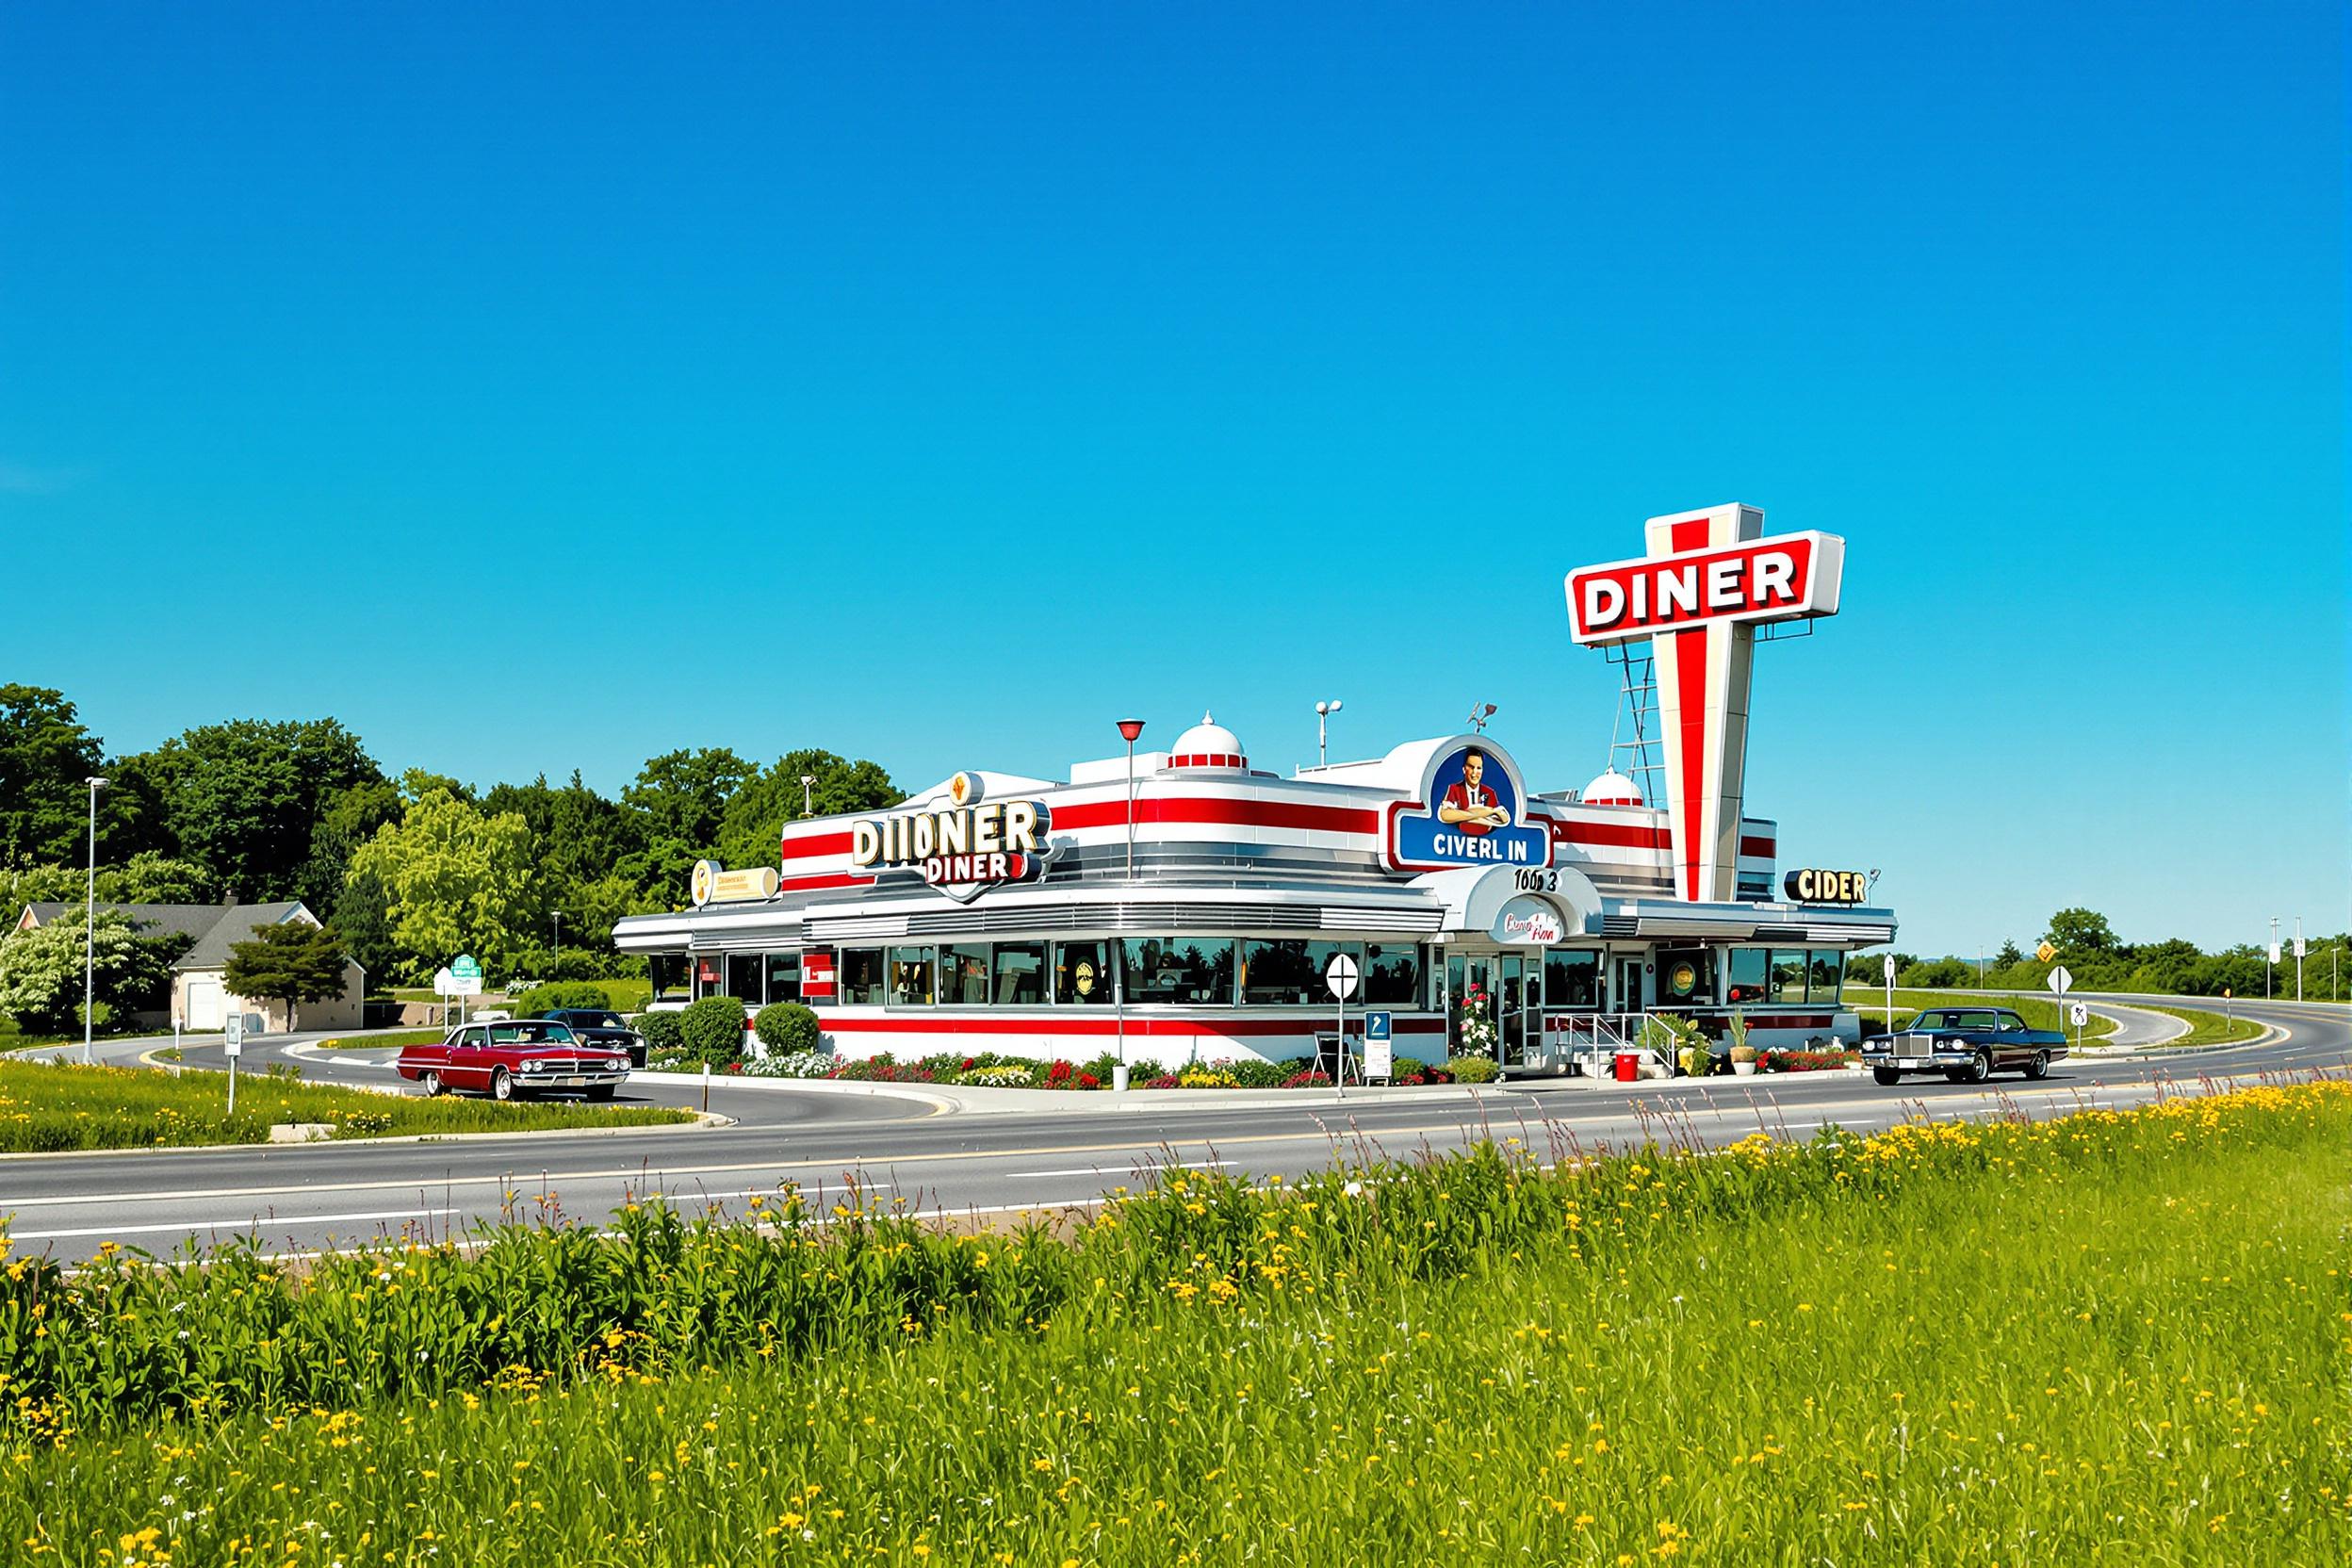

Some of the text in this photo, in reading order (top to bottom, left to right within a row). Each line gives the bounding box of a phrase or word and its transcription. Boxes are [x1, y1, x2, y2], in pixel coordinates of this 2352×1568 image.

[1584, 552, 1795, 627] DINER
[1433, 833, 1527, 861] CIVERL IN
[926, 853, 1008, 884] DINER
[1798, 869, 1866, 901] CIDER
